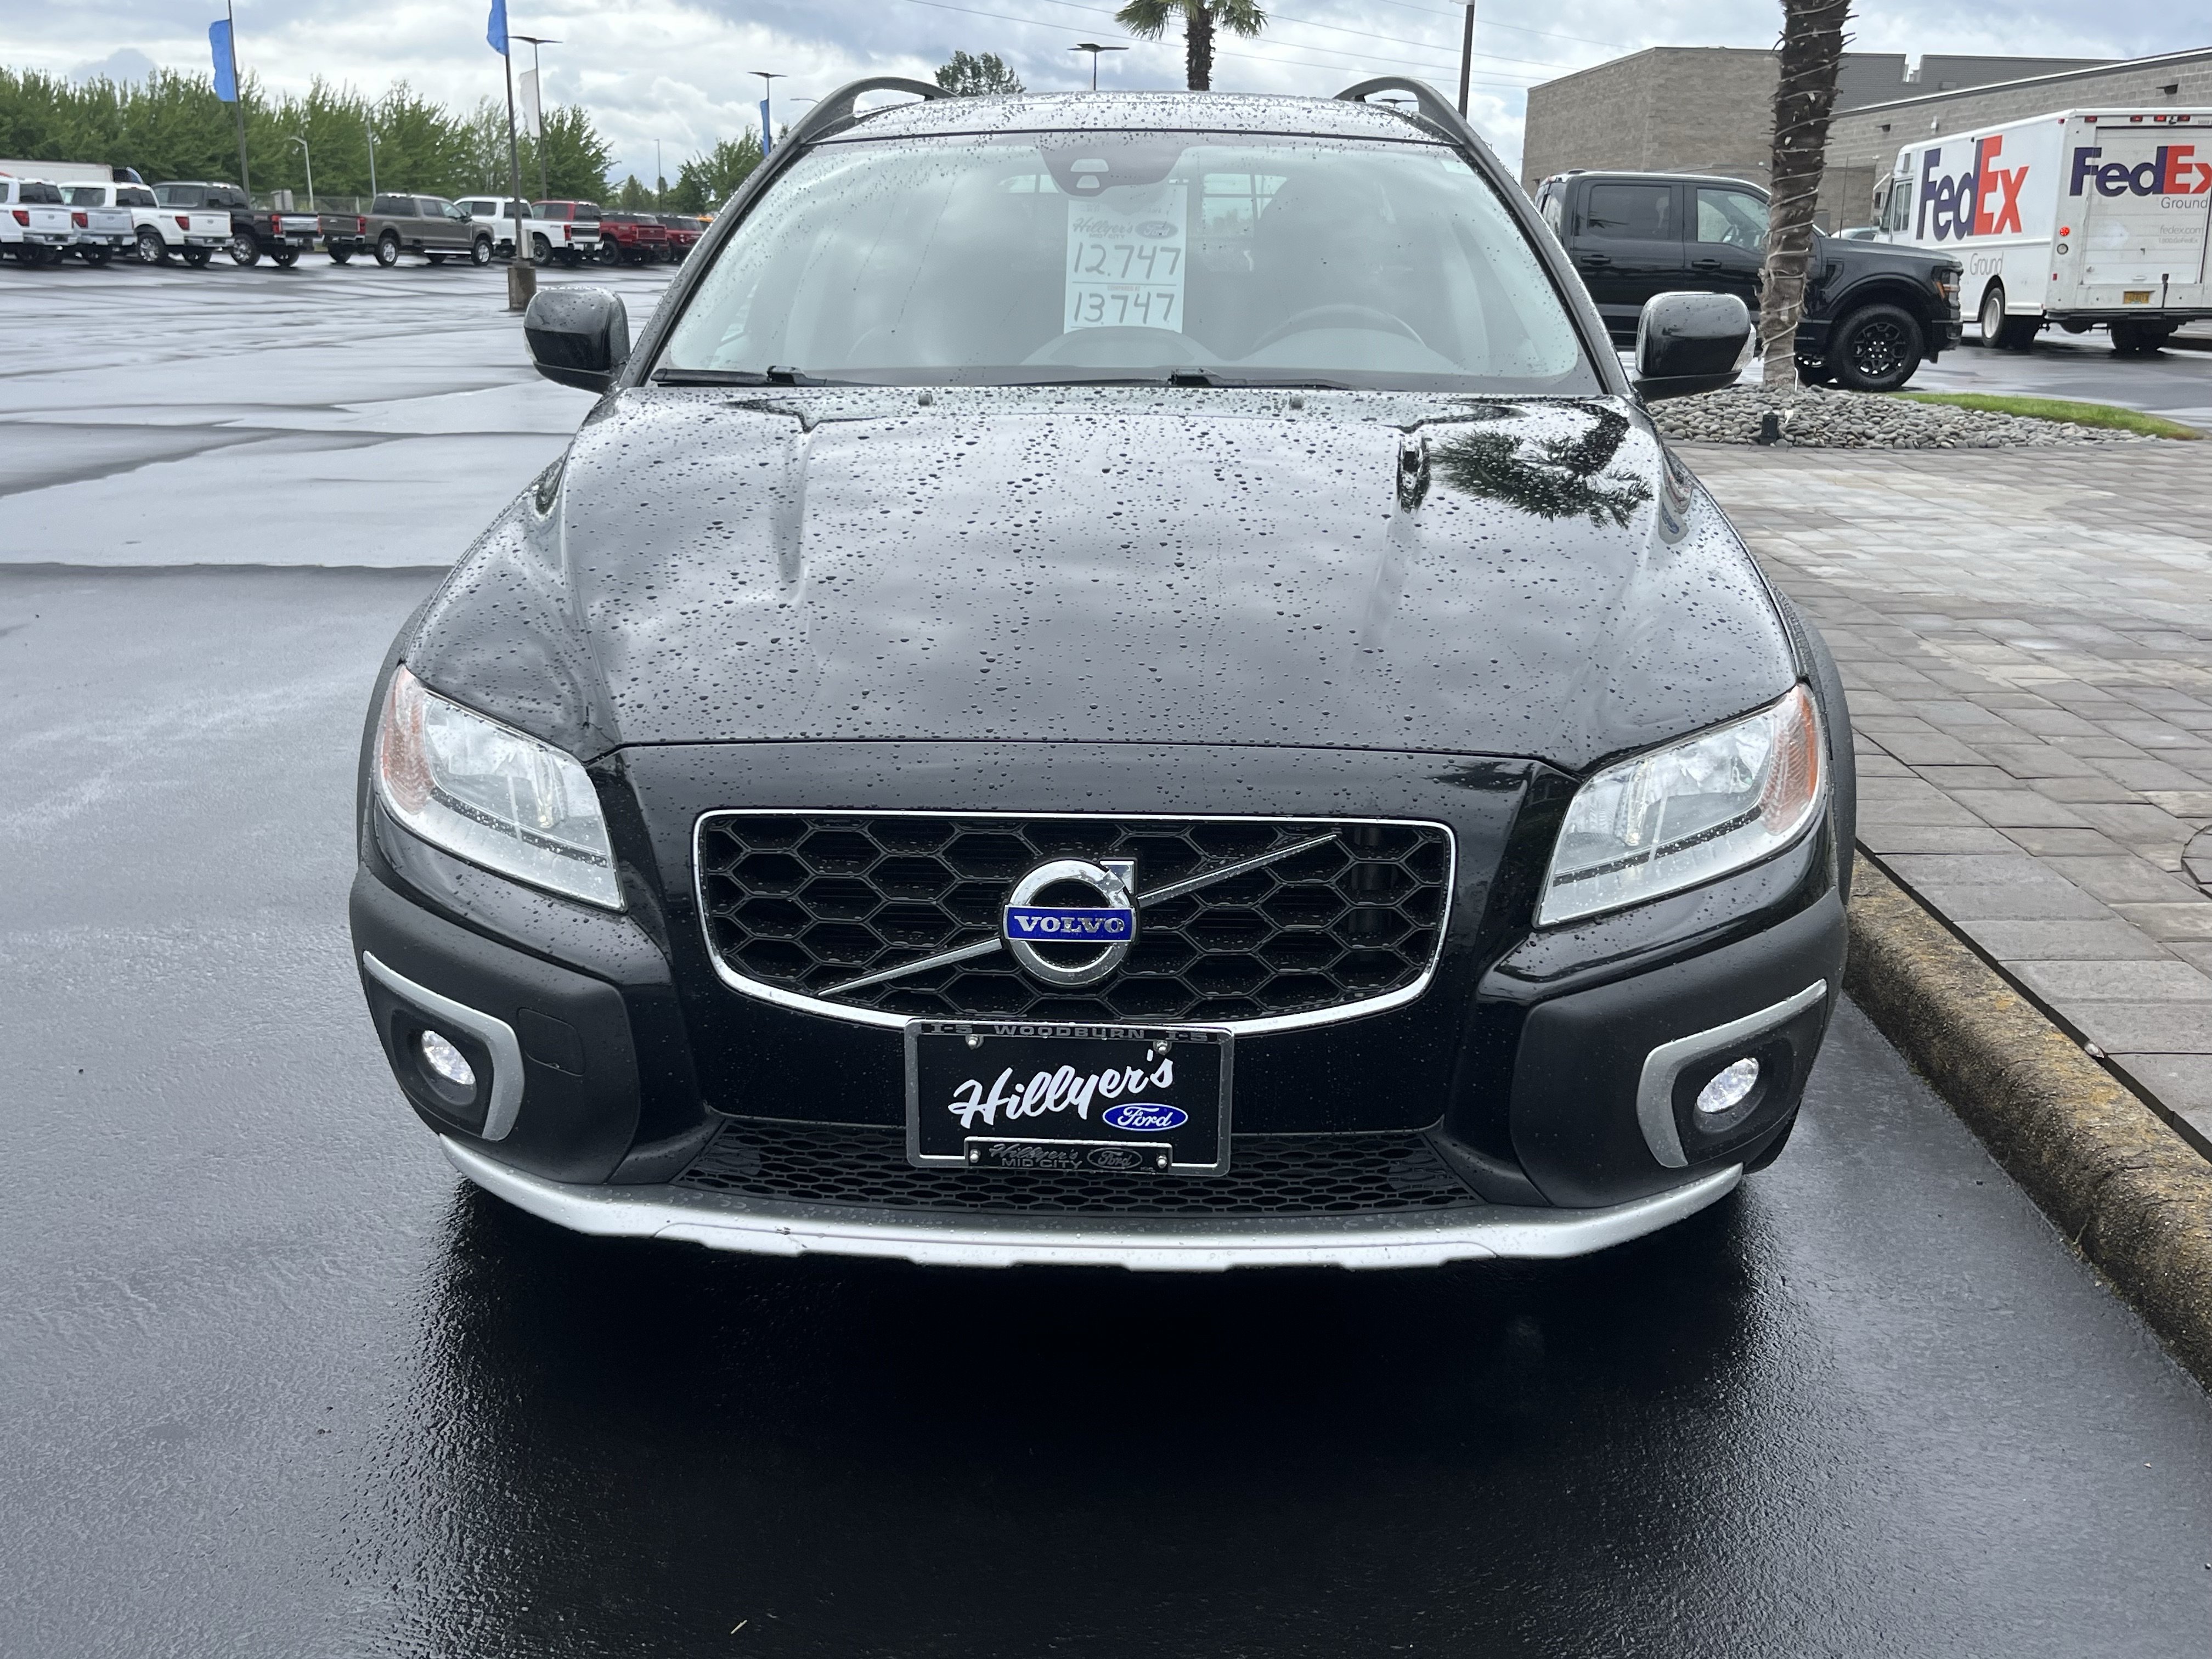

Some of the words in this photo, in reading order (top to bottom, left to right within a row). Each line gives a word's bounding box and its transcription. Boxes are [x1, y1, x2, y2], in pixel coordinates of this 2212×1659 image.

[1916, 135, 2029, 241] FedEx
[2161, 196, 2208, 208] Ground
[1073, 217, 1133, 236] Hillyer's
[2160, 224, 2204, 235] fedex.com
[1970, 251, 2004, 275] Ground
[1014, 916, 1125, 933] VOLVO
[930, 1024, 973, 1034] I-5
[994, 1025, 1145, 1039] WOODBURN
[1165, 1030, 1208, 1042] I-5
[947, 1049, 1173, 1129] Hillyer's
[1116, 1105, 1172, 1127] Ford
[989, 1143, 1079, 1163] Hillyer's
[1098, 1150, 1132, 1167] Ford
[1001, 1158, 1034, 1167] MID
[1040, 1159, 1083, 1169] CITY
